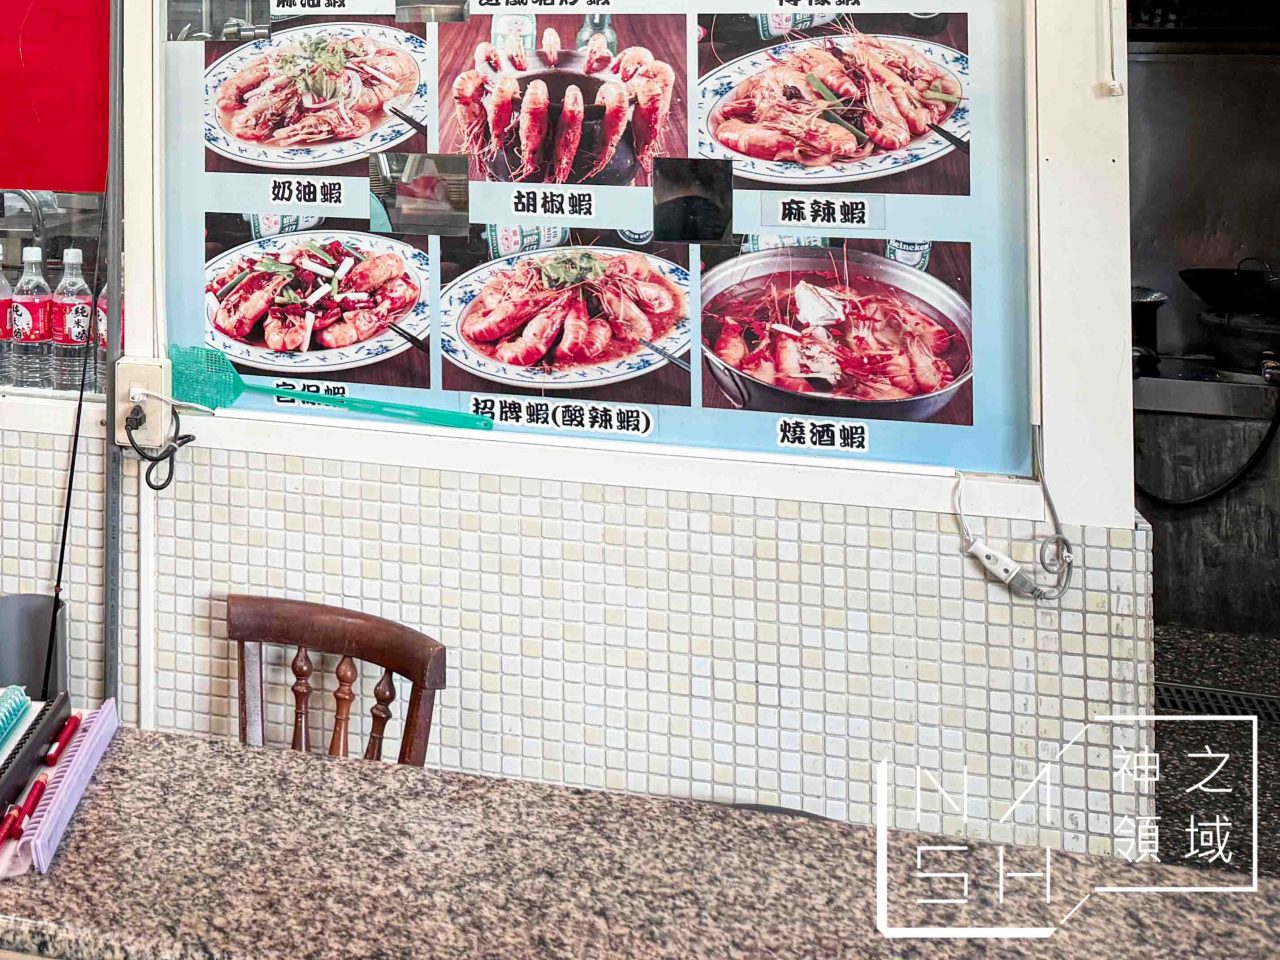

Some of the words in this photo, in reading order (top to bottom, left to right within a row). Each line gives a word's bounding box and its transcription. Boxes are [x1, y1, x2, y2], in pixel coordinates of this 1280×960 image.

[271, 180, 342, 204] 奶油蝦
[514, 191, 593, 216] 胡椒蝦
[781, 198, 866, 224] 麻辣蝦
[780, 422, 865, 449] 燒酒蝦
